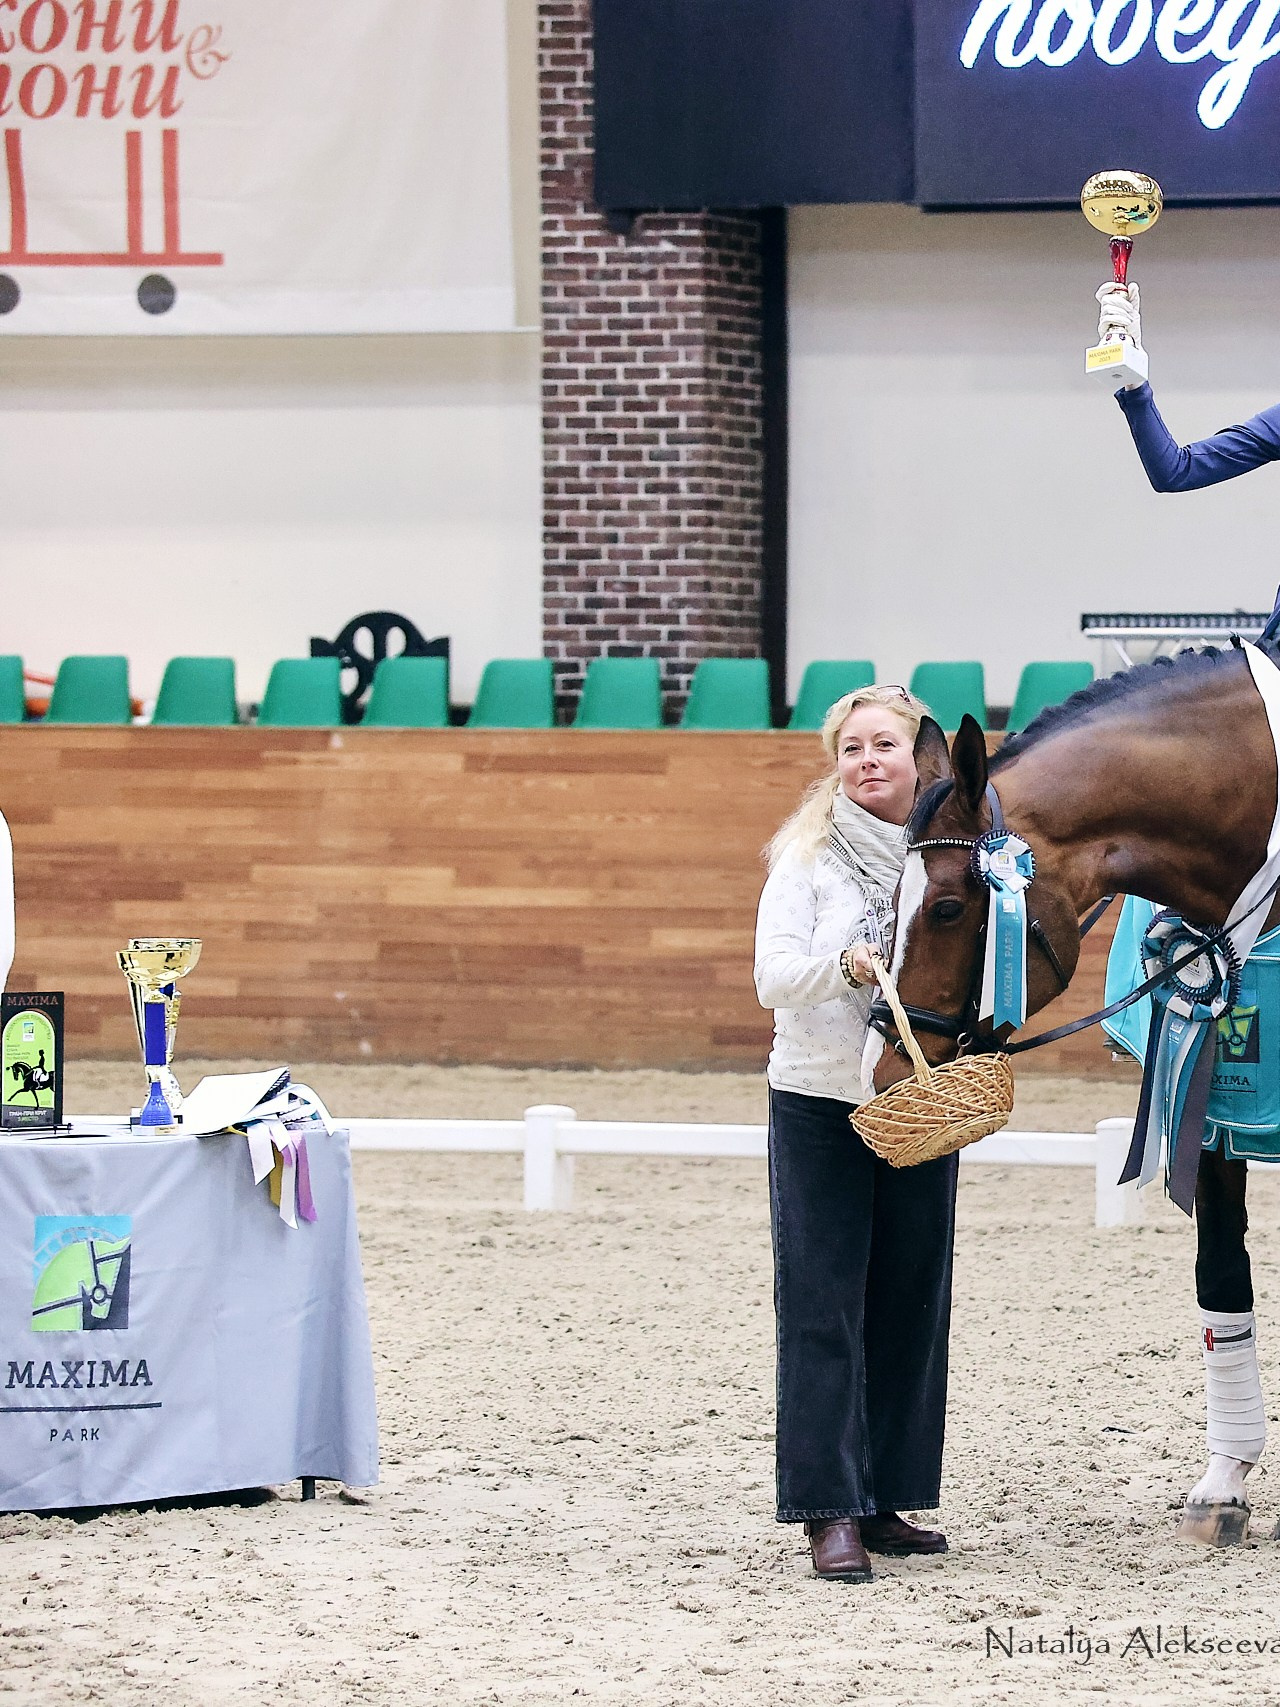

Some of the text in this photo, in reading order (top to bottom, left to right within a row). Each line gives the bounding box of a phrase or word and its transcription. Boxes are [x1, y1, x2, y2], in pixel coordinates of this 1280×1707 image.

[6, 995, 59, 1006] MAXIMA
[1211, 1074, 1251, 1086] XIMA
[5, 1359, 153, 1389] MAXIMA
[49, 1427, 100, 1442] PARK
